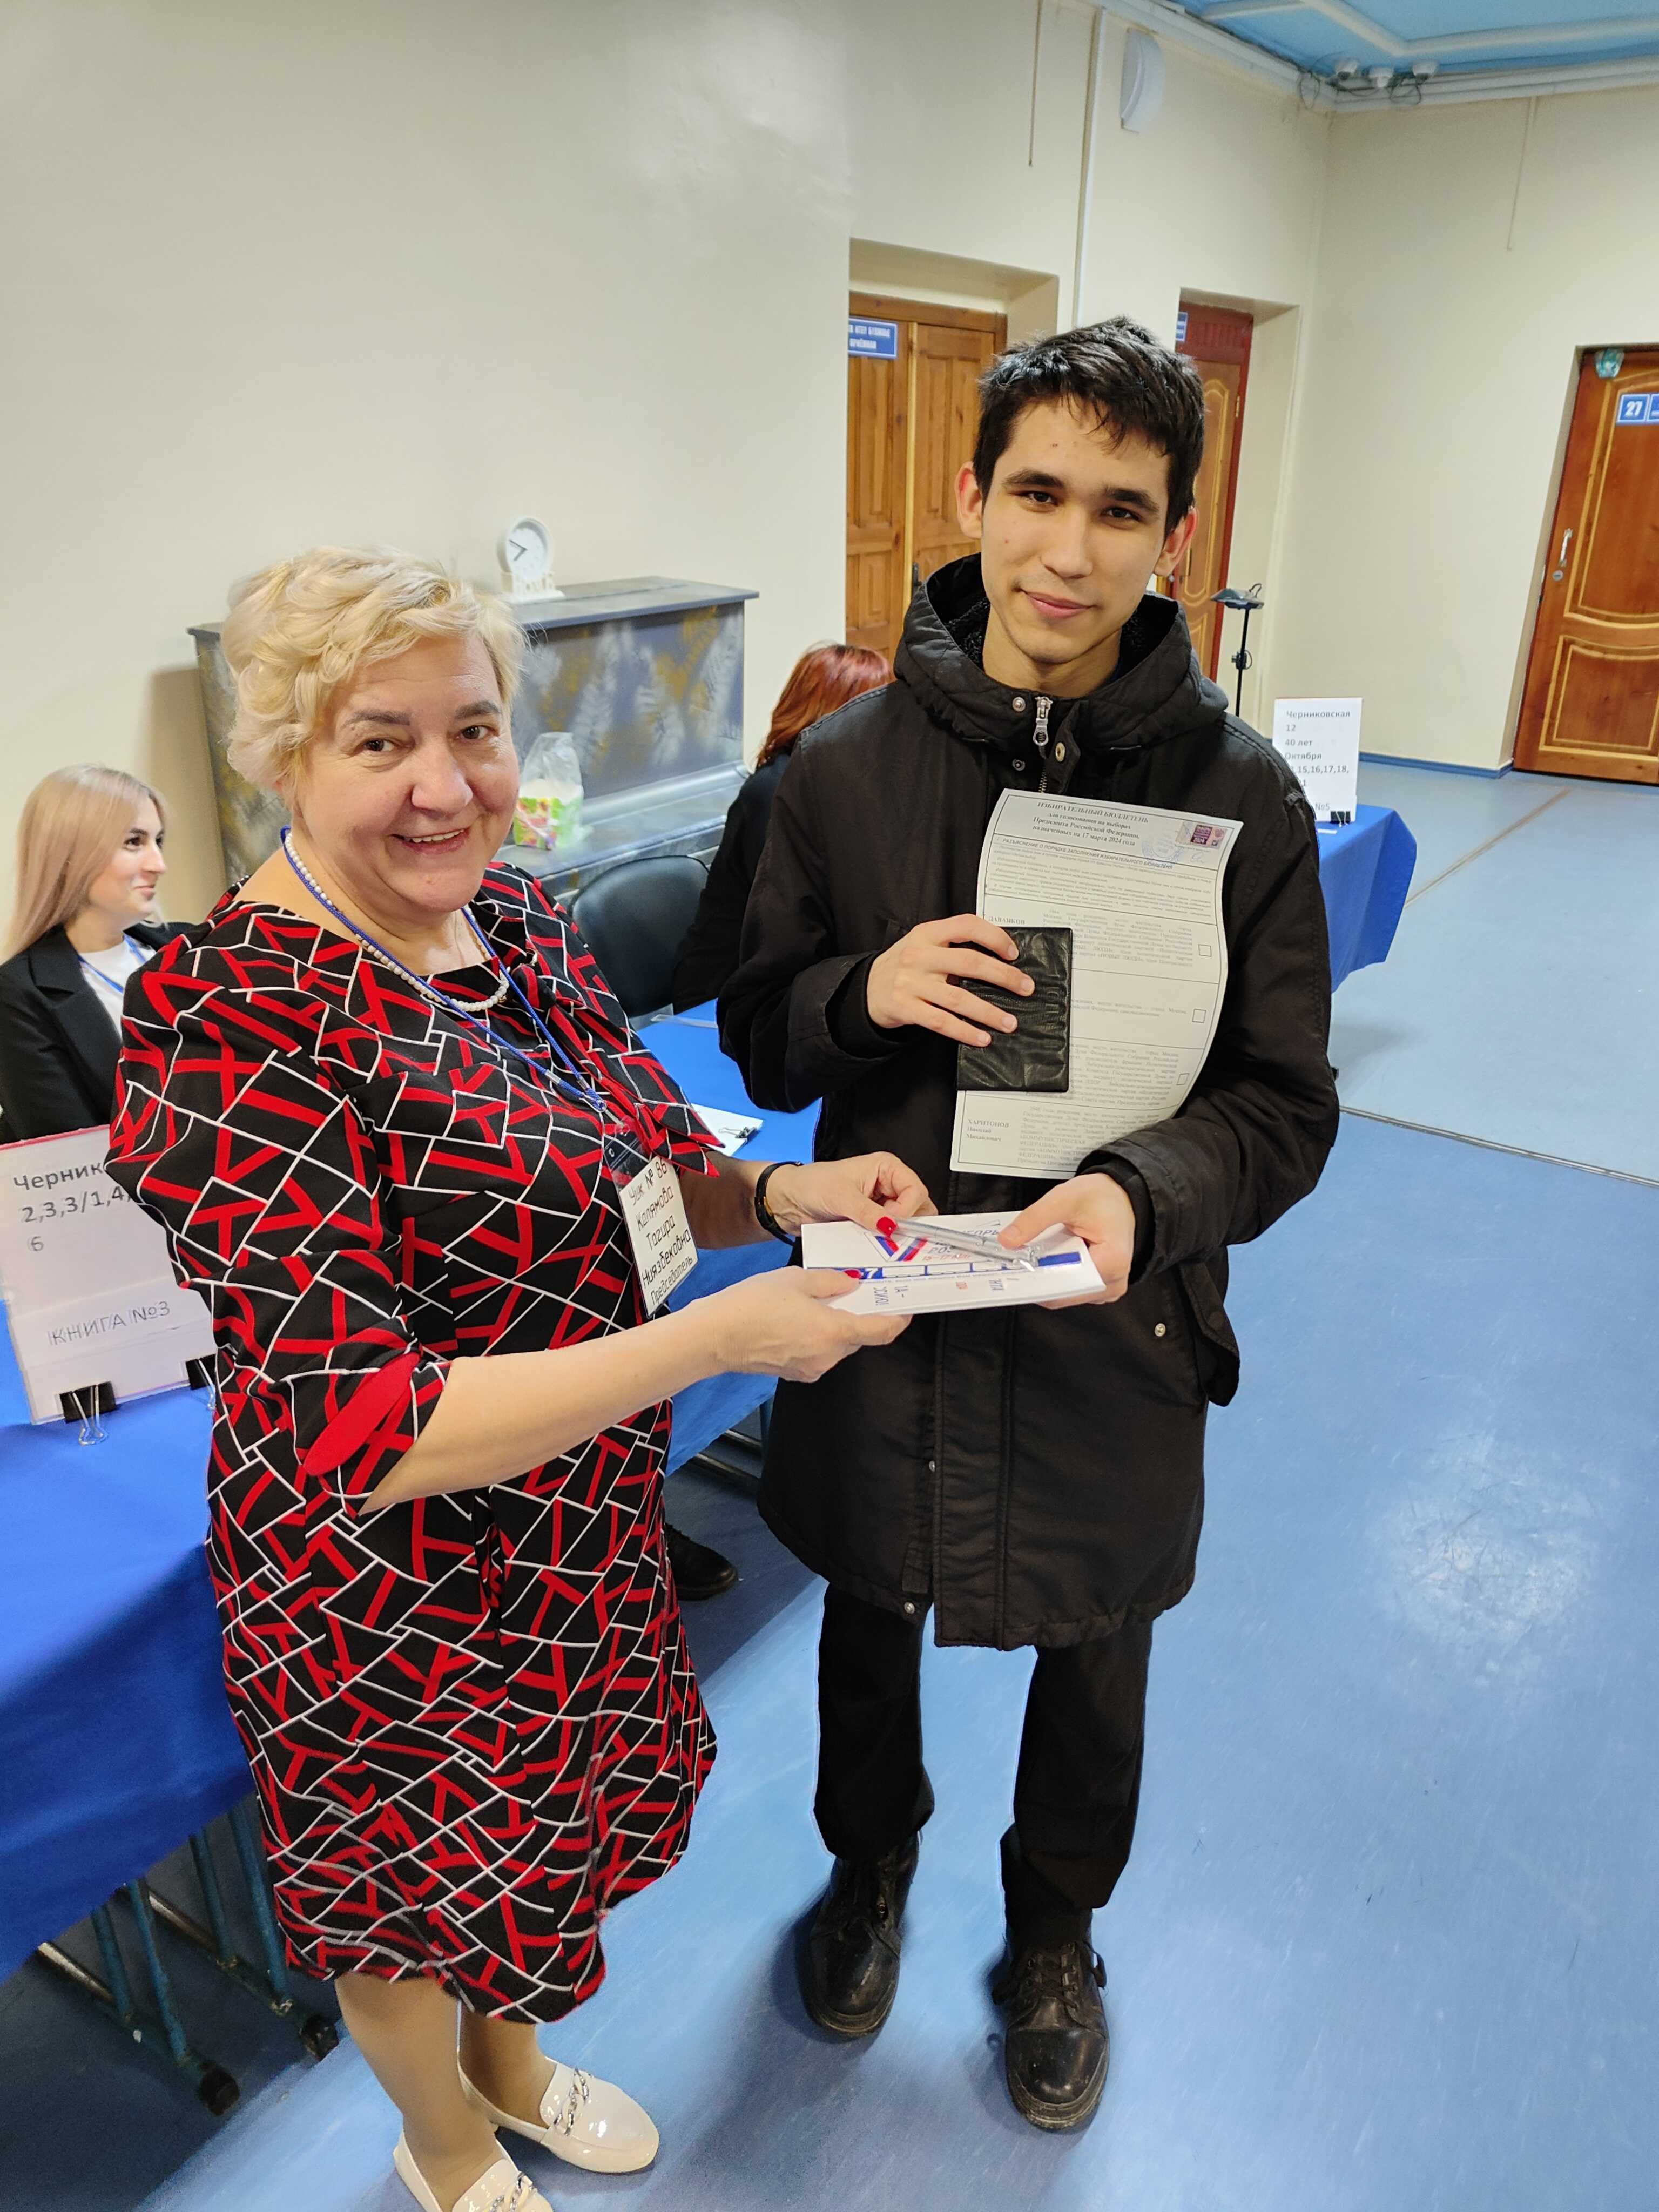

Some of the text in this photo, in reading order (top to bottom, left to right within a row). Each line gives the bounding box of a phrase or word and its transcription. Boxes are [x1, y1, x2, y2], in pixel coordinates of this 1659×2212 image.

[1625, 401, 1643, 417] 27
[1286, 710, 1350, 719] Черниковская
[1285, 752, 1321, 761] Октября
[1037, 802, 1149, 823] ИЗБИРАТЕЛЬНЫЙ БЮЛЛЕТЕНЬ
[1033, 817, 1068, 827] Президента
[1070, 822, 1105, 833] Российской
[1033, 826, 1071, 835] назначенных
[1060, 814, 1097, 824] голосования
[1106, 821, 1131, 830] выборах
[1002, 838, 1038, 848] РАЗЪЯСНЕНИЕ
[1044, 844, 1067, 853] ПОРЯДКЕ
[1067, 848, 1100, 858] ЗАПОЛНЕНИЯ
[1100, 854, 1143, 865] ИЗБИРАТЕЛЬНОГО
[968, 1119, 1009, 1128] ХАРИТОНОВ
[655, 1159, 667, 1178] 86
[636, 1186, 674, 1231] Калямова
[646, 1215, 676, 1251] Тагира
[27, 1236, 44, 1251] 6
[642, 1228, 692, 1289] Ниязбековна
[650, 1256, 693, 1305] Председатель
[49, 1300, 171, 1345] КНИГА №3
